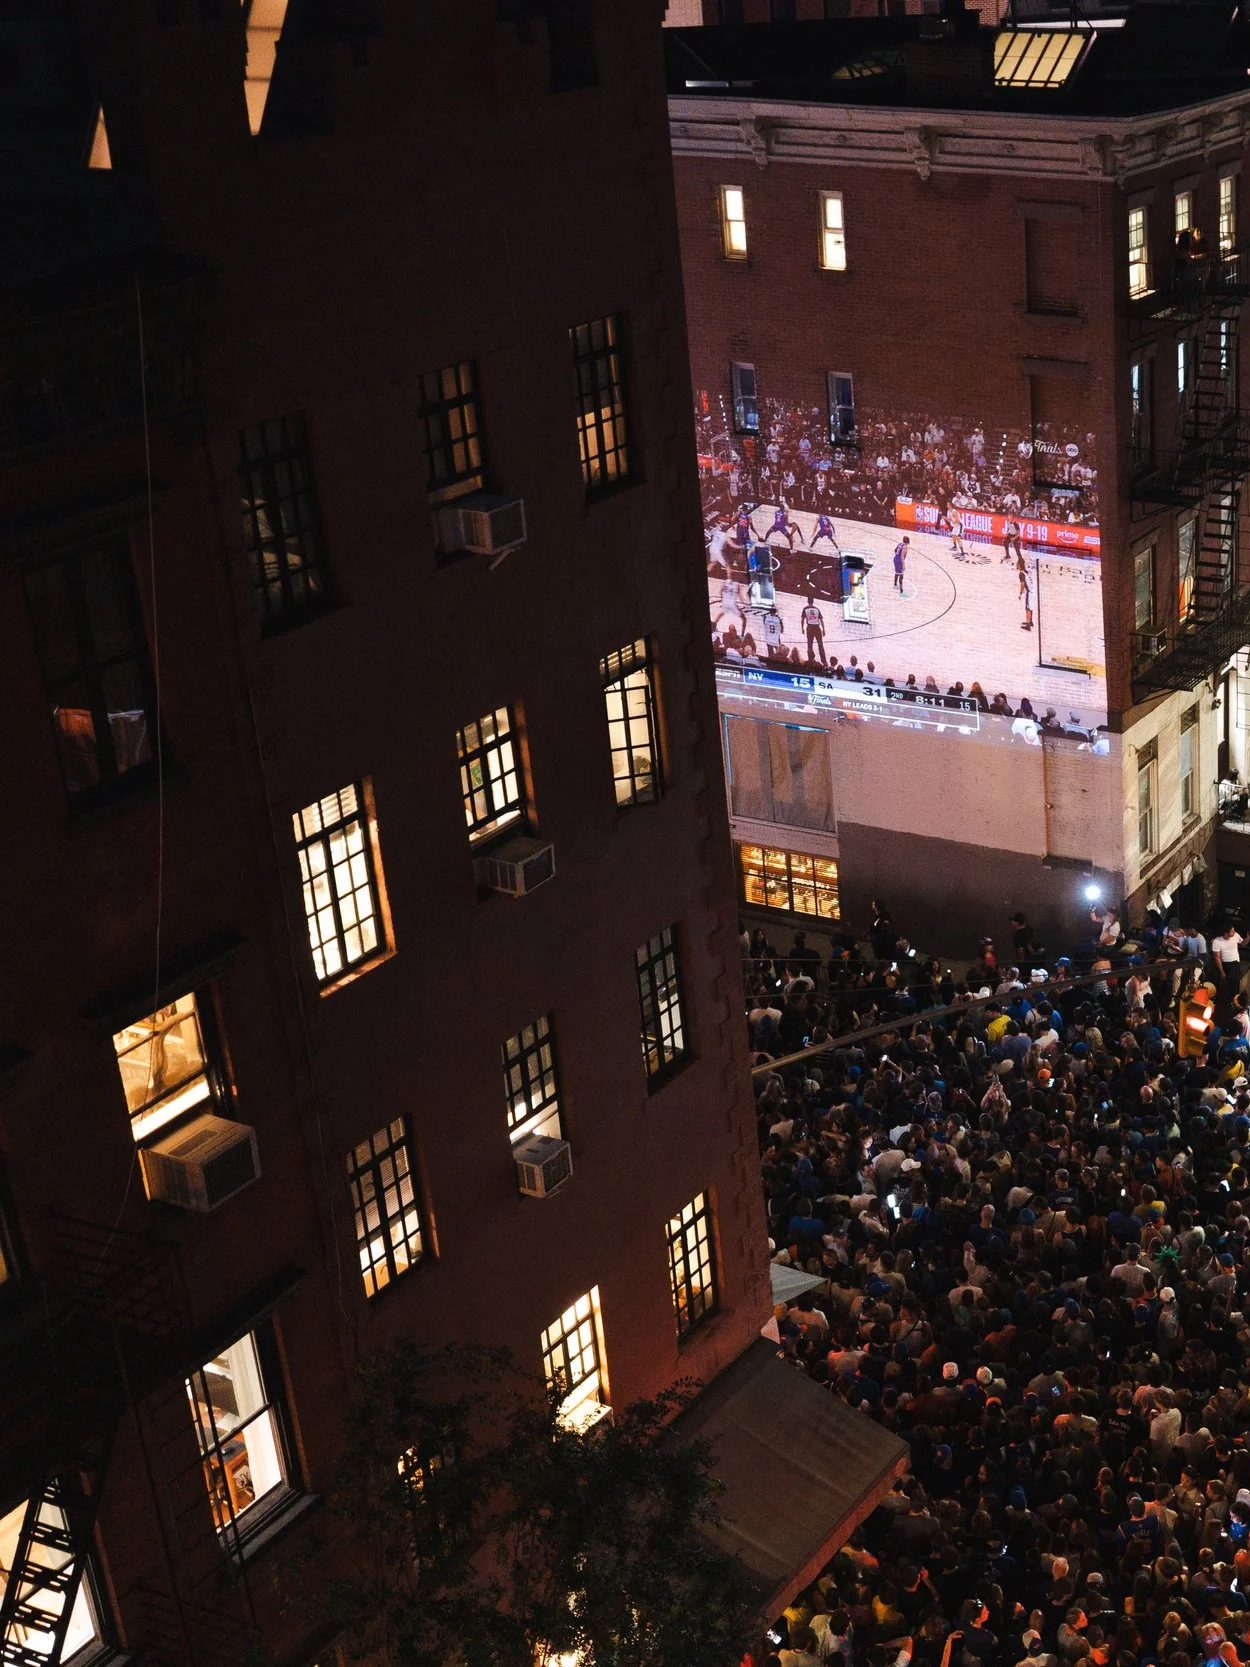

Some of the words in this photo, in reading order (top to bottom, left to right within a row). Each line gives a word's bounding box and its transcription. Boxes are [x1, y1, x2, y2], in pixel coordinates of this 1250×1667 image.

[962, 512, 993, 532] LEAGUE
[1002, 519, 1025, 538] JY
[1027, 524, 1048, 541] 9-19
[748, 671, 764, 680] NY
[791, 677, 811, 688] 15
[818, 682, 834, 690] SA
[862, 687, 881, 697] 31
[853, 702, 872, 710] LEADS
[891, 692, 904, 700] 2ND
[915, 695, 945, 707] 8:11
[960, 702, 970, 711] 15
